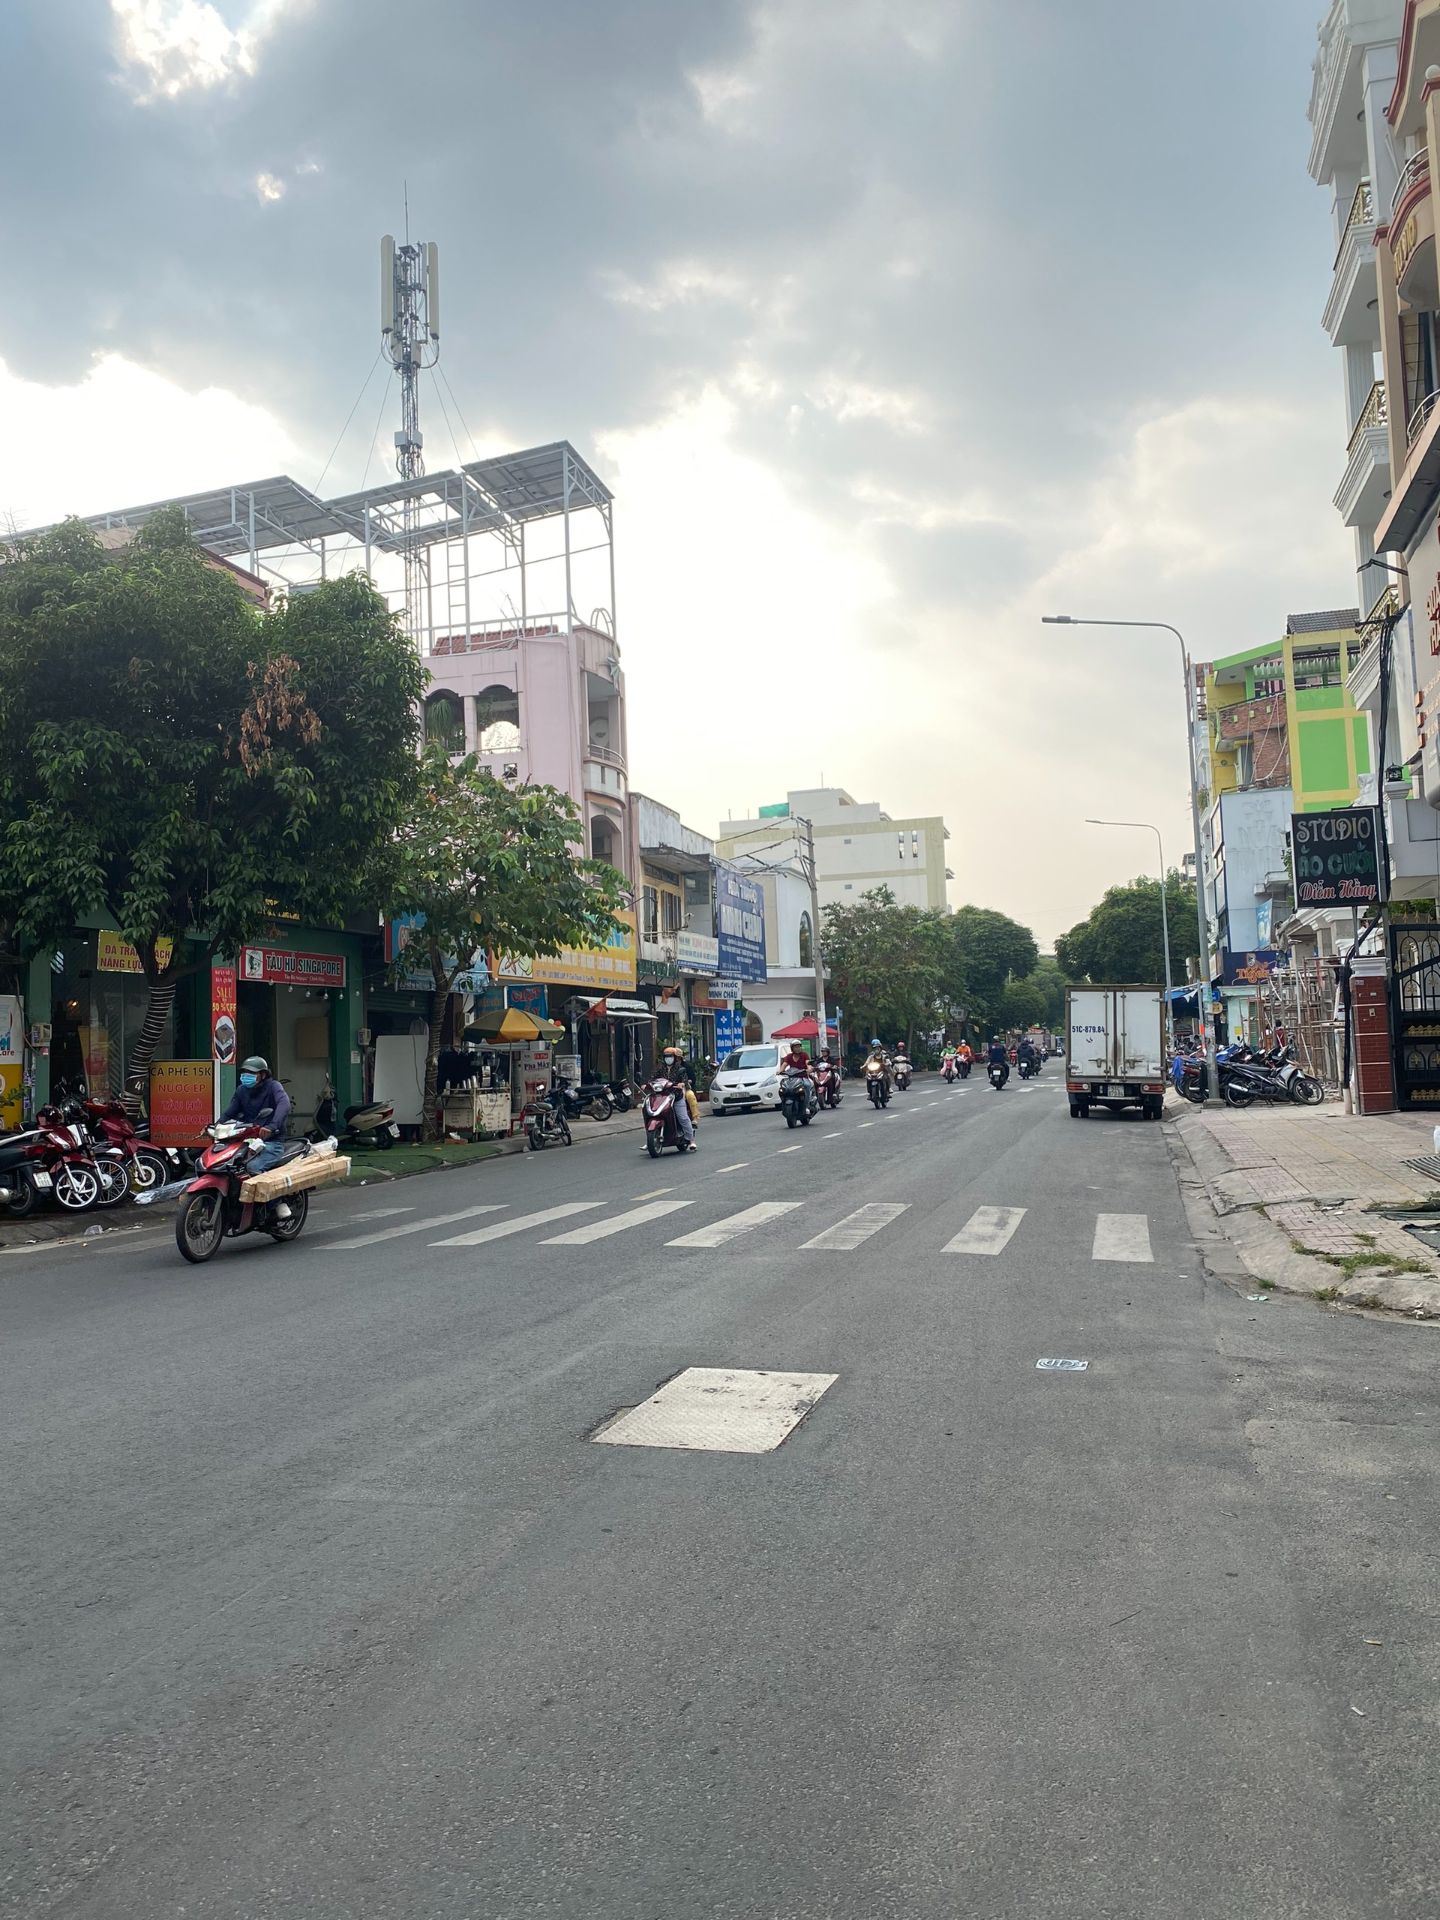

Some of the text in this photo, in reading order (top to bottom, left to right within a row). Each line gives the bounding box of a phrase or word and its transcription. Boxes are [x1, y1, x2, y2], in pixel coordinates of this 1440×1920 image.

[1297, 817, 1371, 843] STUDIO
[297, 958, 341, 976] SINGAPORE
[193, 1067, 211, 1076] 15K
